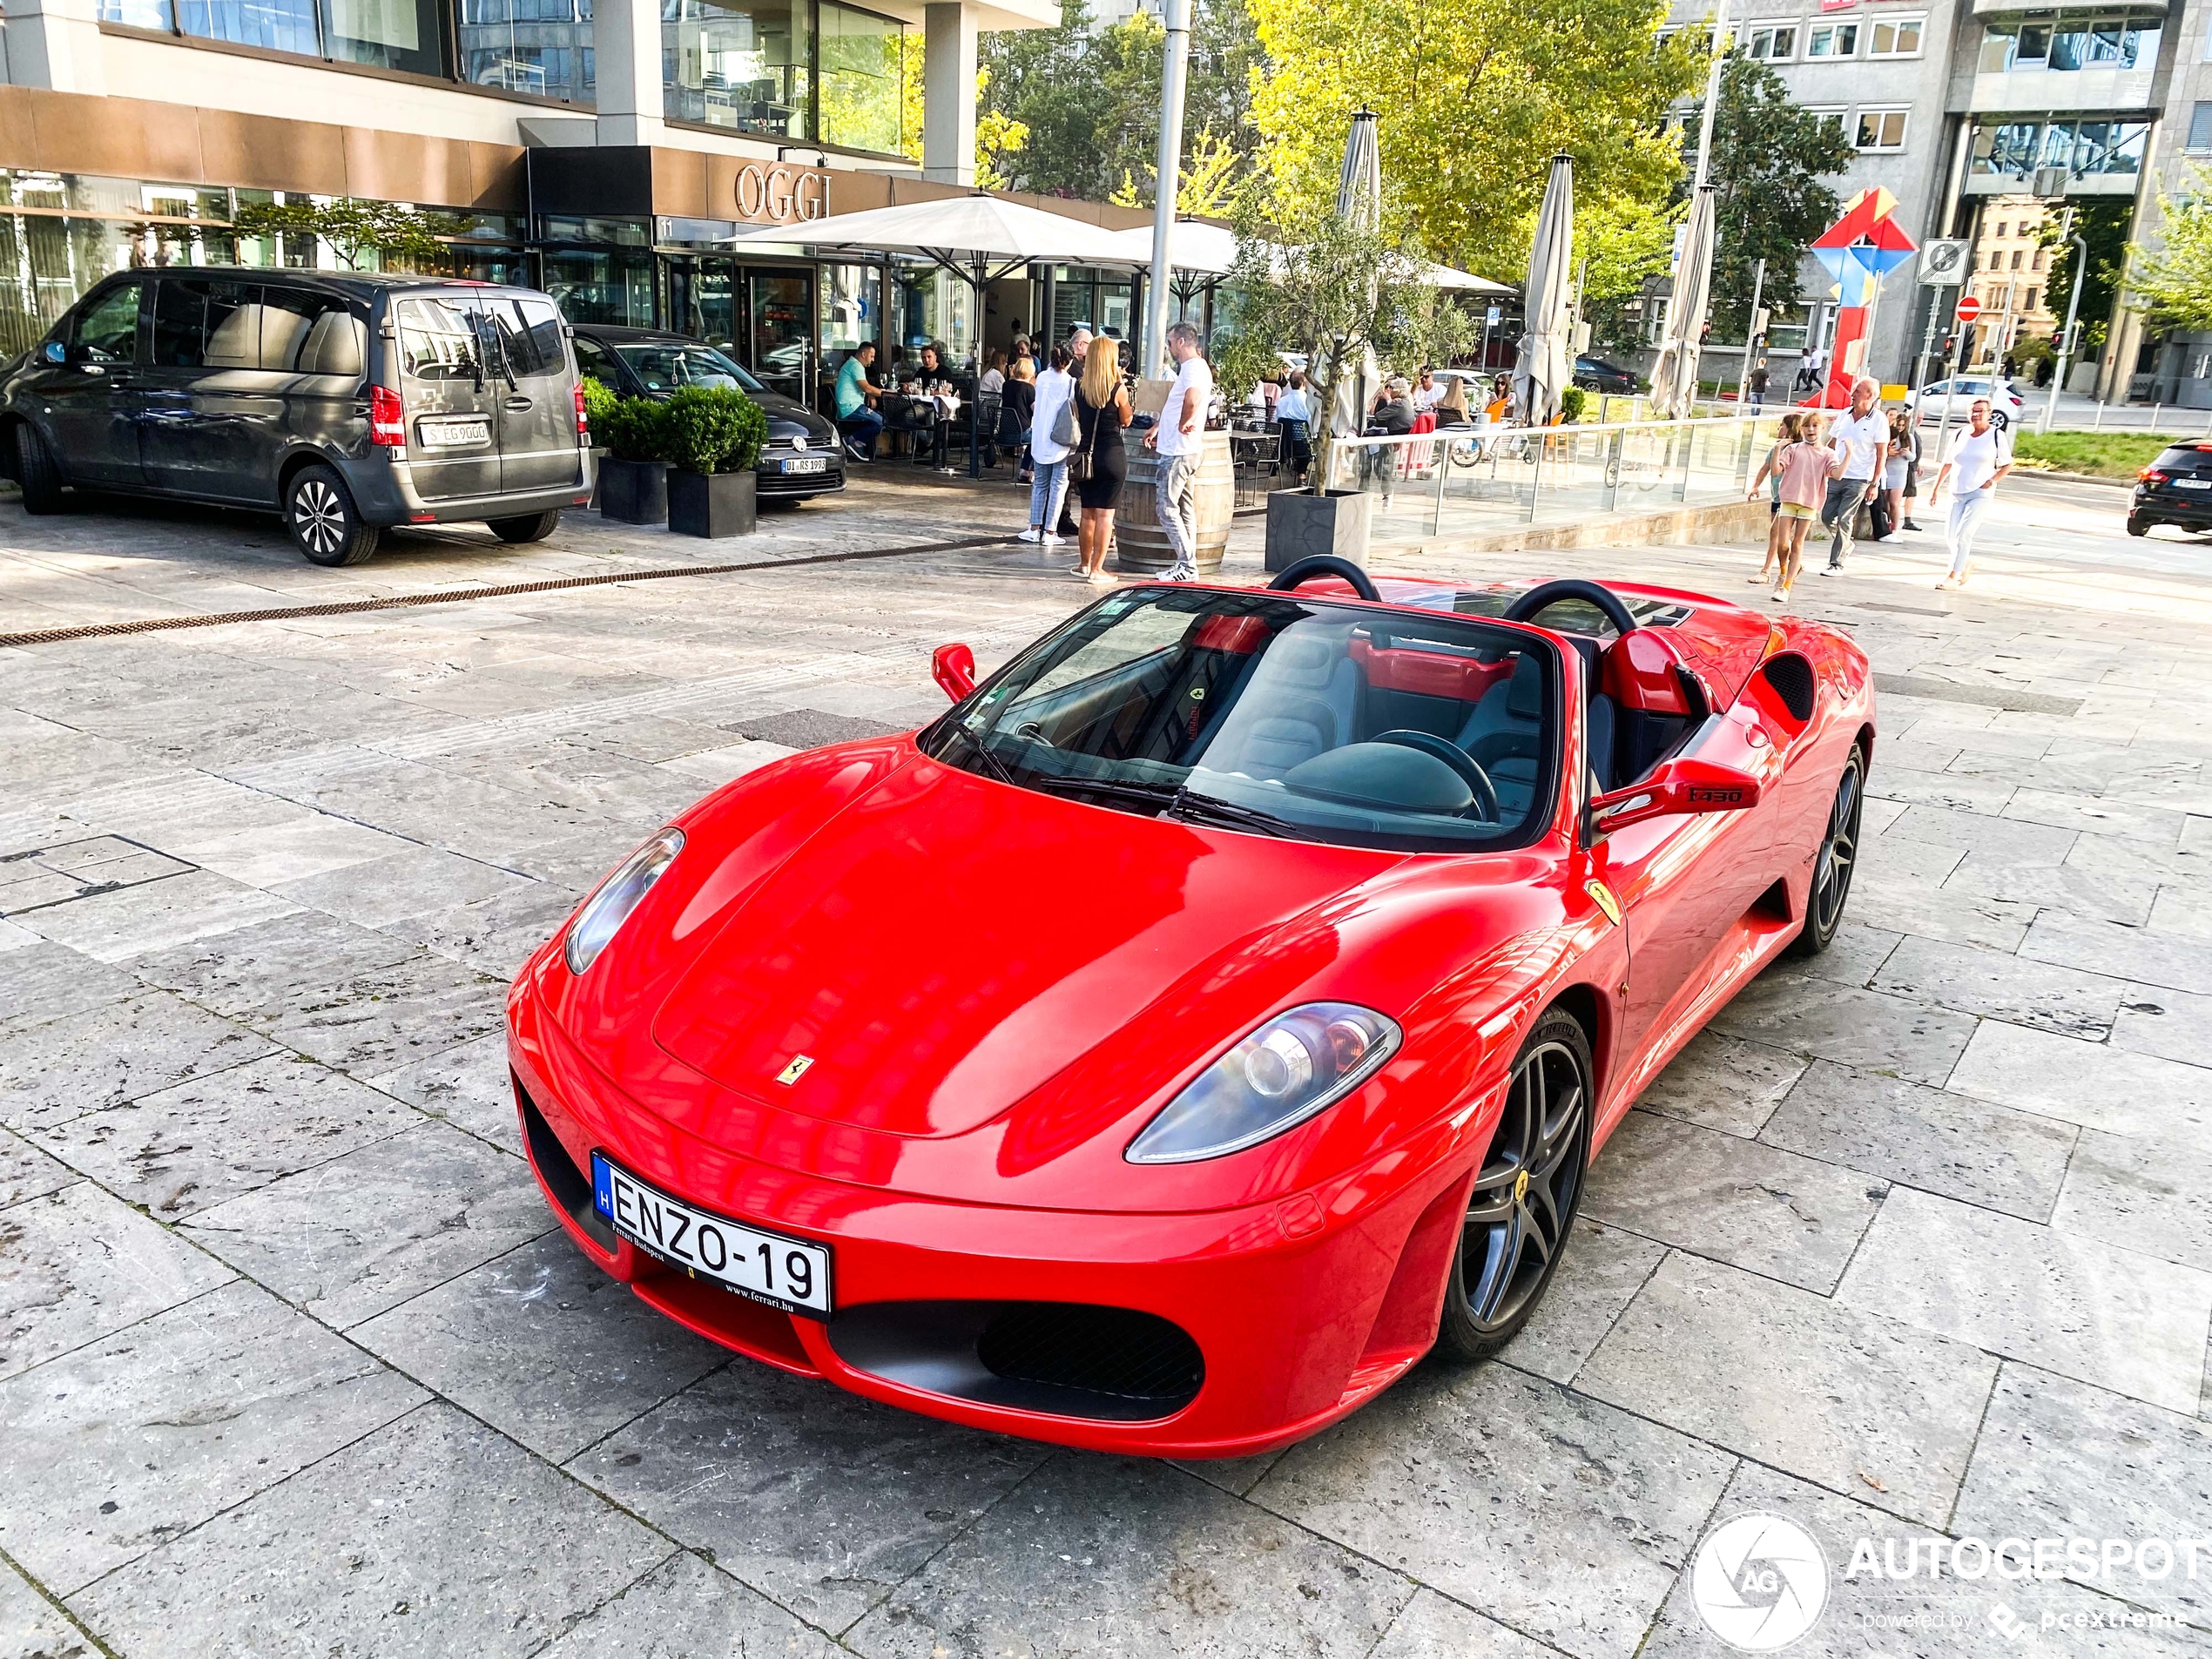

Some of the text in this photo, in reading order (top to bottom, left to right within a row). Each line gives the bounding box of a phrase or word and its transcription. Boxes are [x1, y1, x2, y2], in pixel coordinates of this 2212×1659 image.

[738, 164, 833, 222] OGGI
[660, 219, 674, 238] 11
[444, 428, 458, 441] EG
[787, 460, 826, 470] DI RS 1993
[1689, 787, 1743, 802] F430
[611, 1222, 665, 1262] Ferrari Budapest
[613, 1175, 813, 1300] ENZO-19
[725, 1284, 794, 1312] www.ferrari.hu
